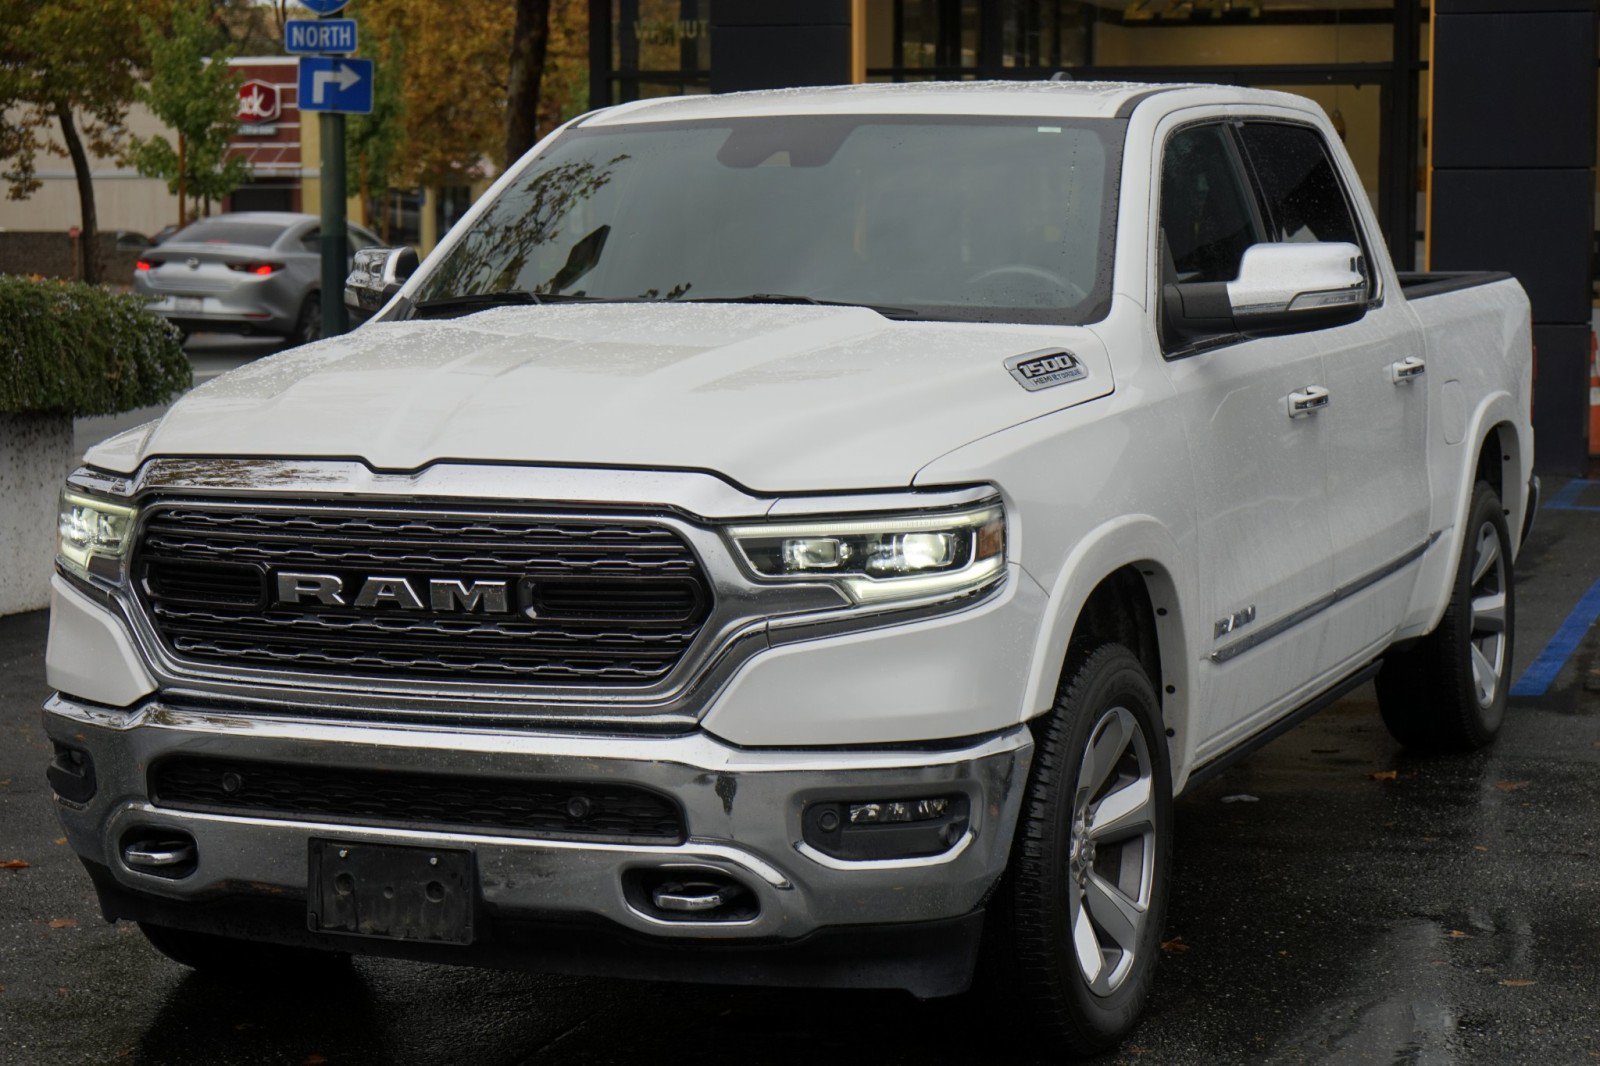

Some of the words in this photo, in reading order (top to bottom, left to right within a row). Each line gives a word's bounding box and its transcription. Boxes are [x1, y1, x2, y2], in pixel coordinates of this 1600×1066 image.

[292, 26, 351, 48] NORTH
[1020, 355, 1073, 378] 1500
[1034, 375, 1053, 385] HEMI
[277, 571, 508, 613] RAM
